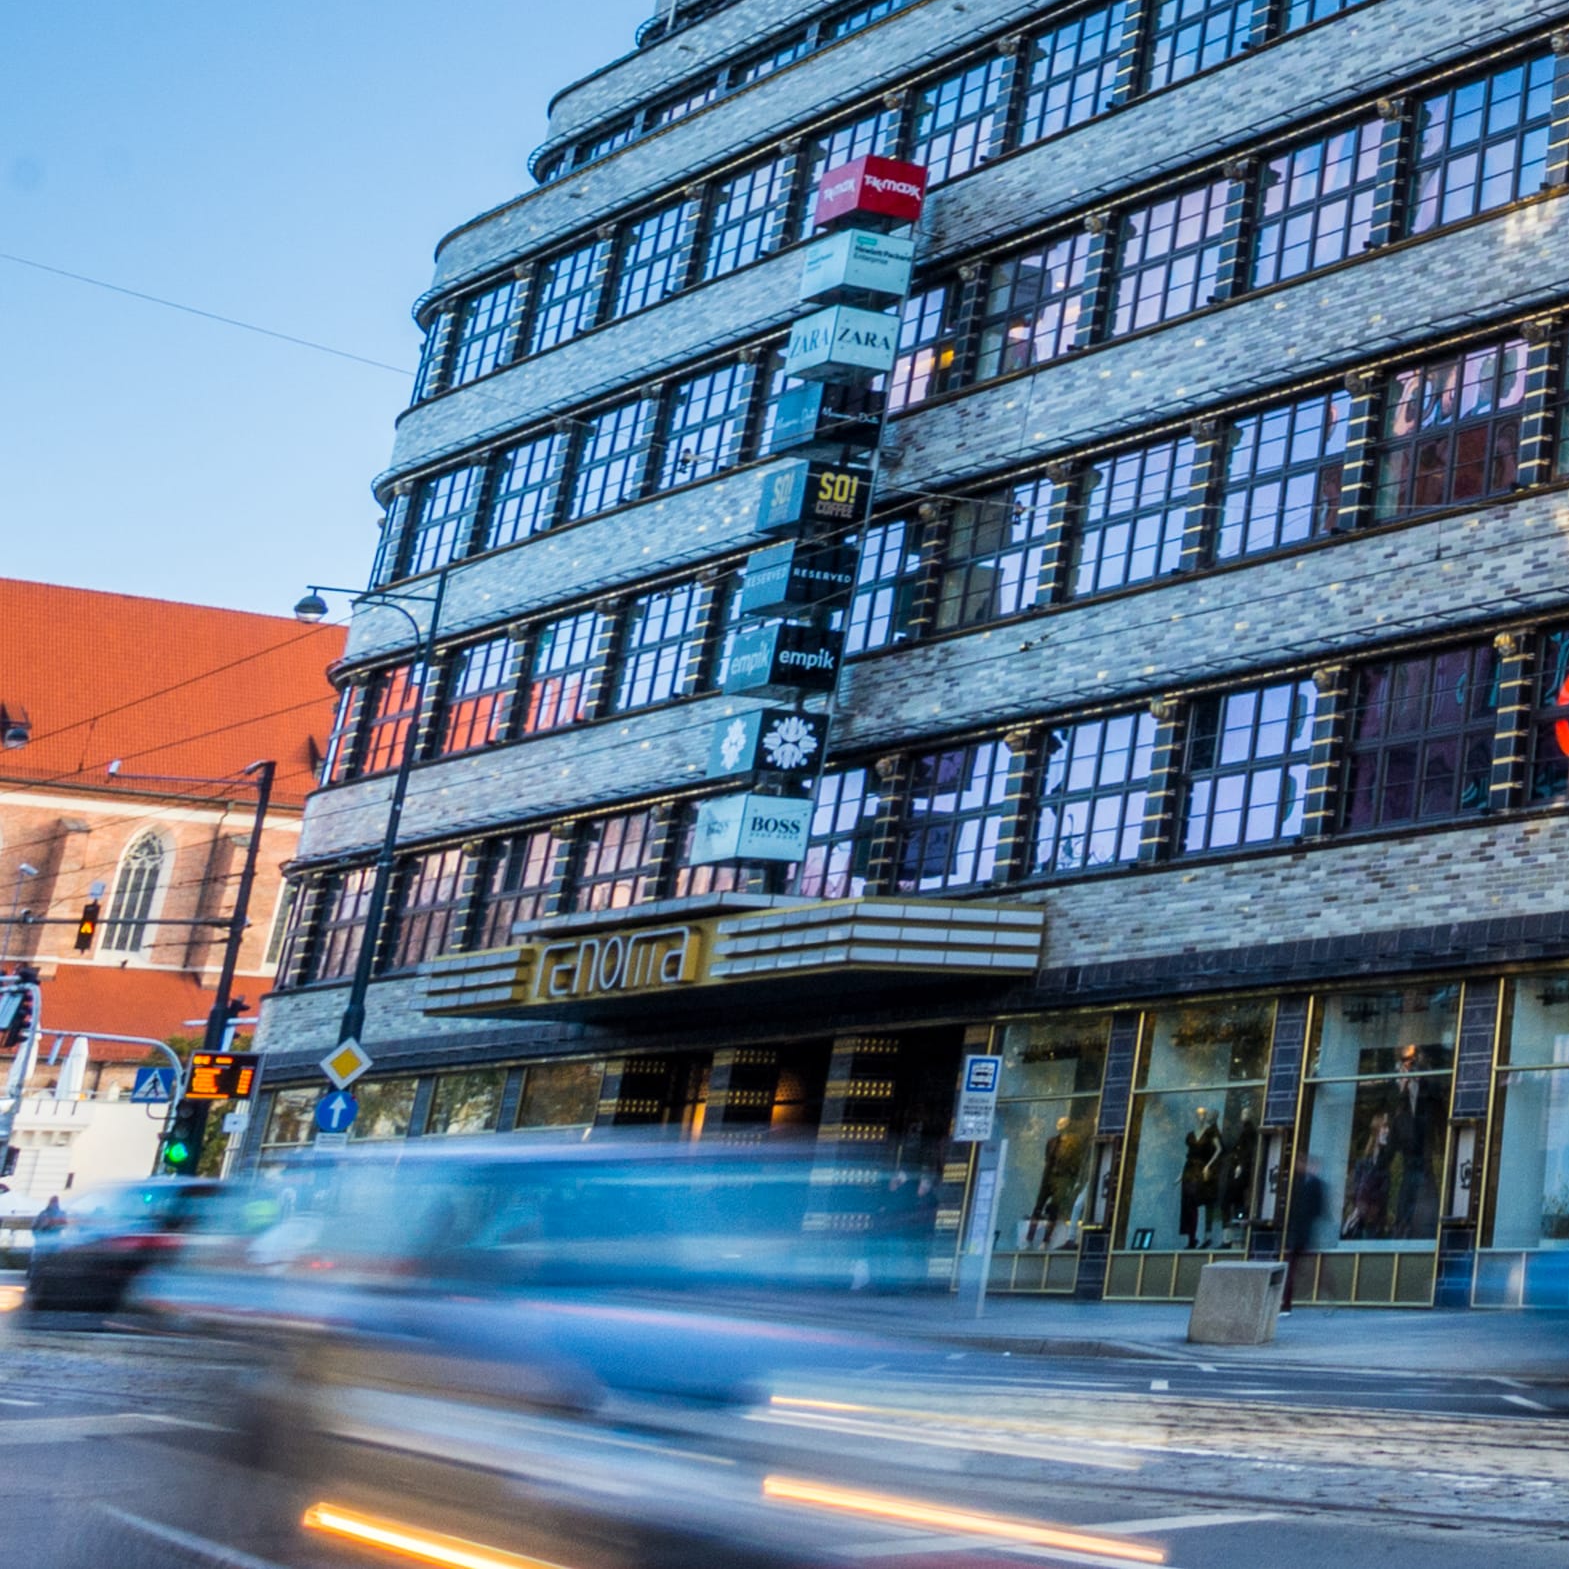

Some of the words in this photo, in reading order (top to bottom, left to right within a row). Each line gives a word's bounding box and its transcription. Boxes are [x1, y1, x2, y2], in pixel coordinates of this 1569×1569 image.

[789, 327, 830, 359] ZARA
[837, 327, 891, 351] ZARA
[817, 471, 860, 504] SO!
[815, 500, 855, 519] COFFEE
[793, 567, 852, 584] RESERVED
[730, 640, 770, 677] empik
[778, 648, 836, 671] empik
[750, 816, 801, 836] BOSS
[534, 925, 691, 998] renoma
